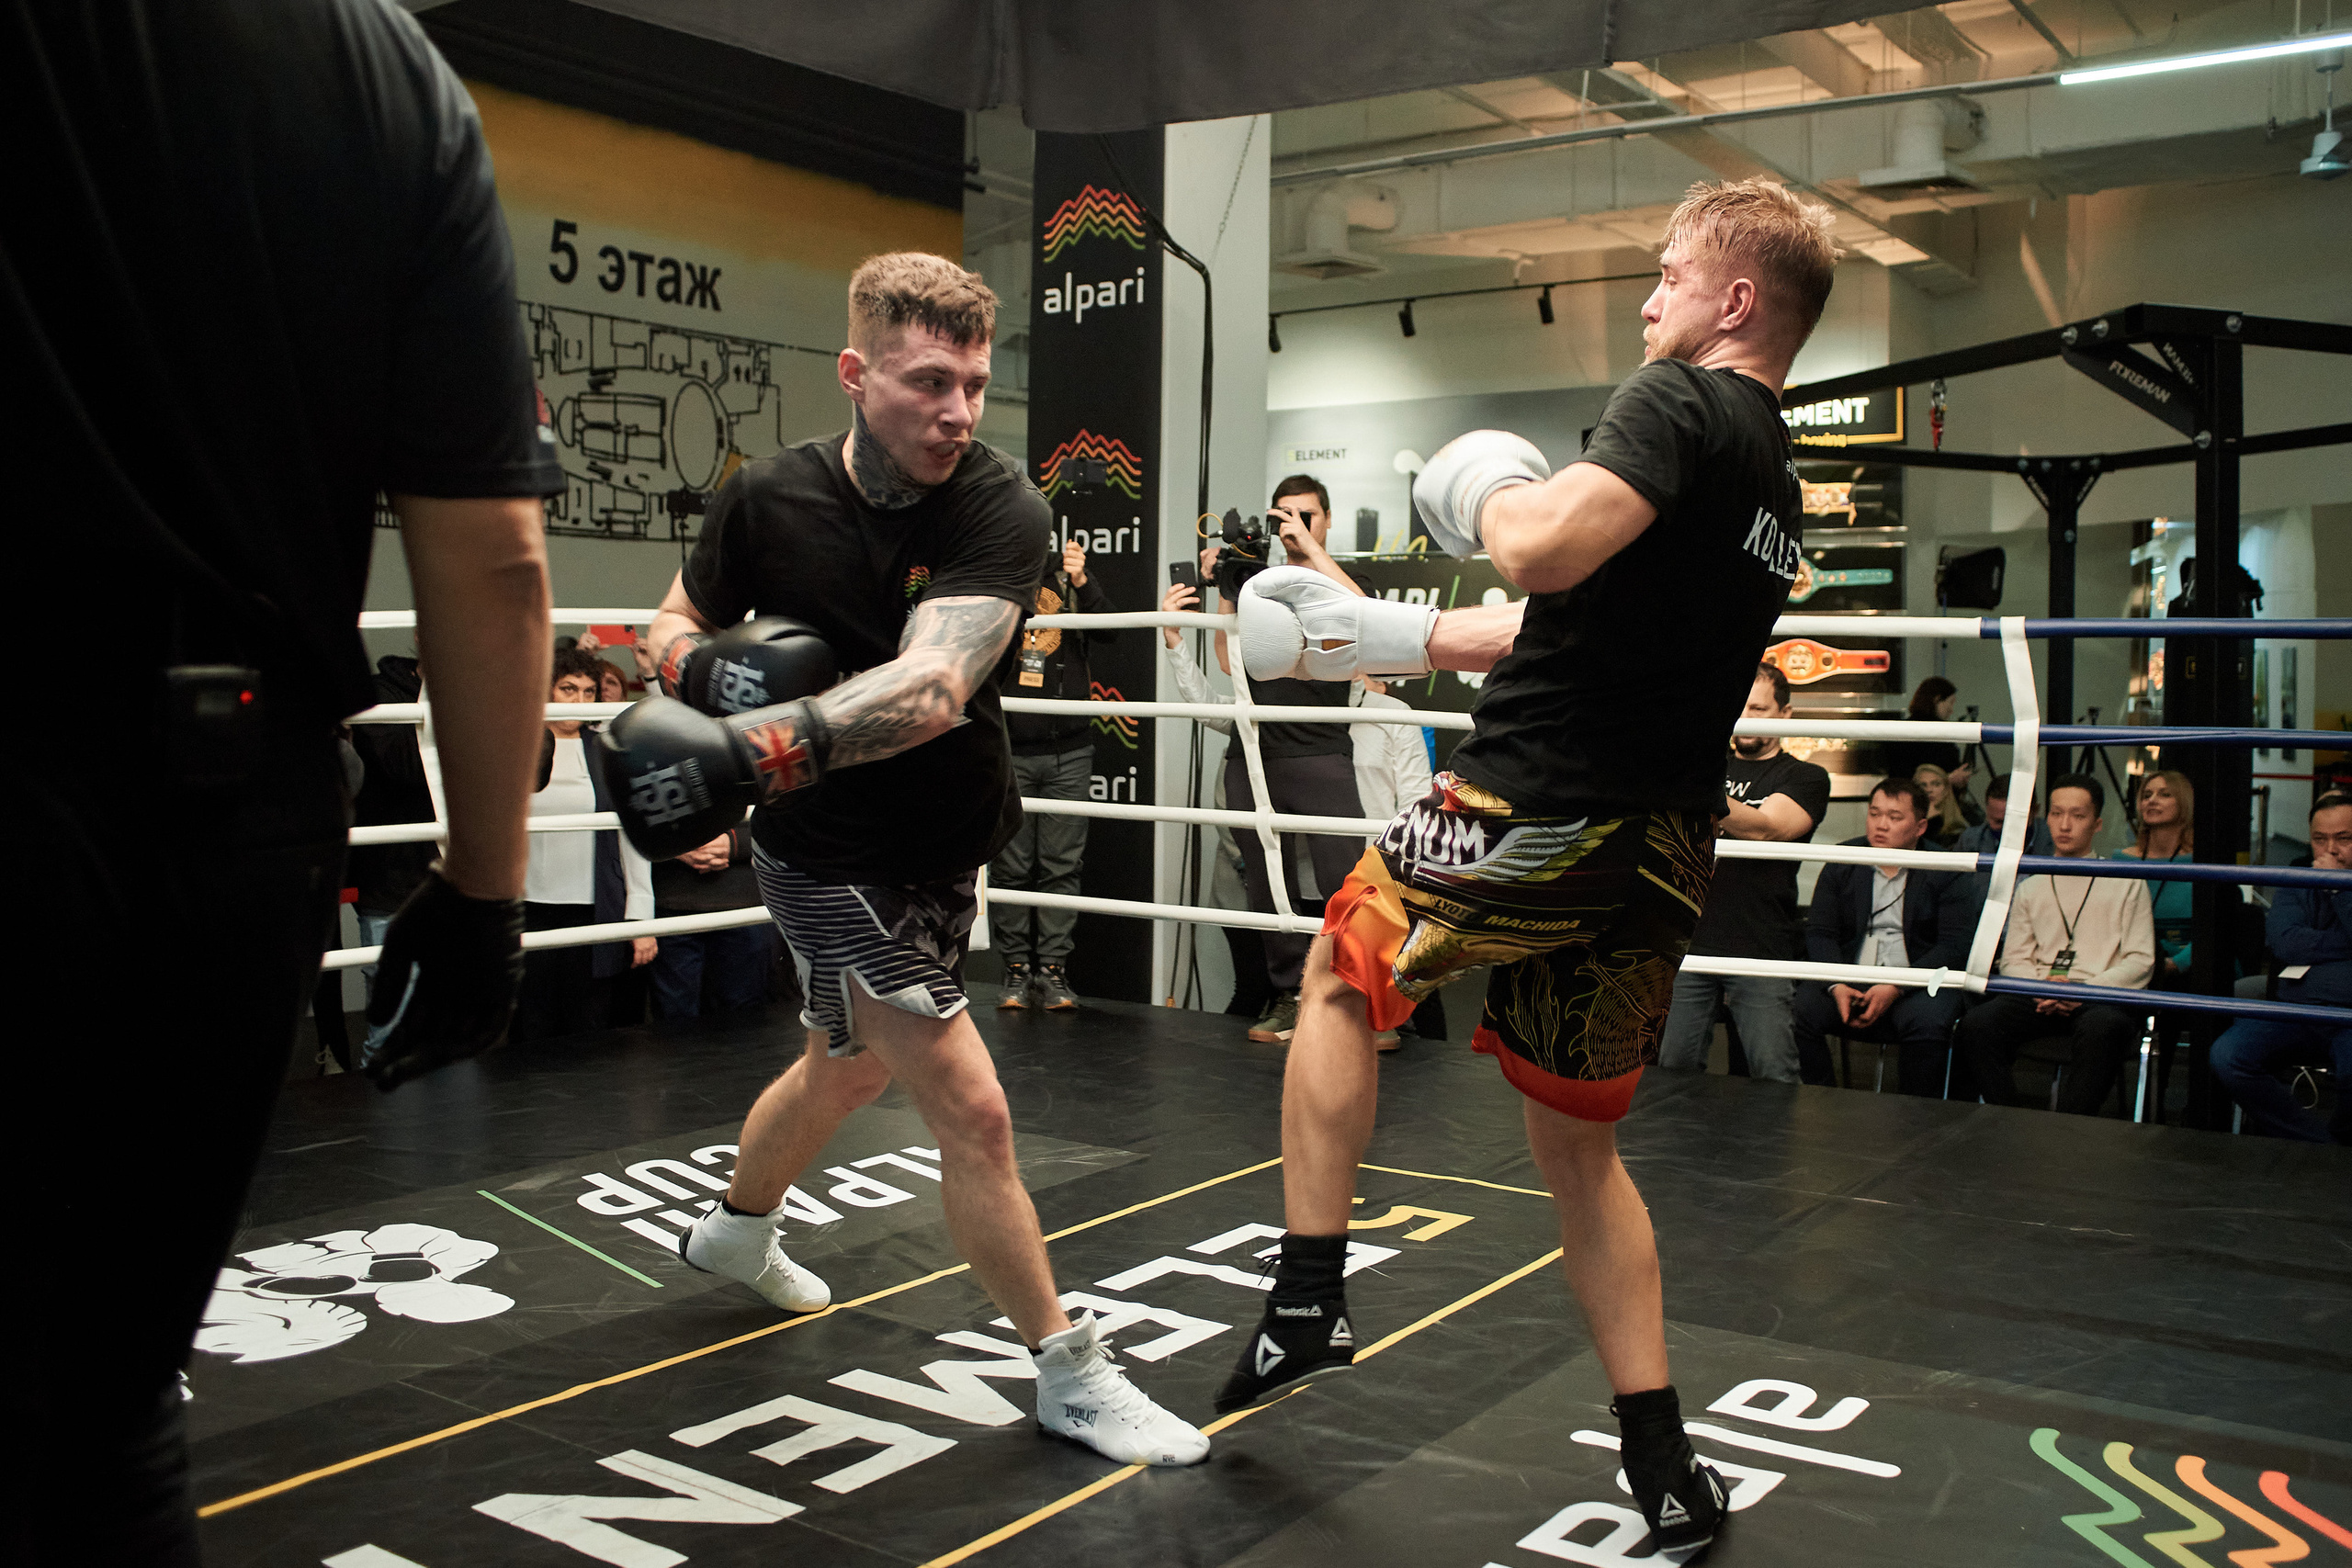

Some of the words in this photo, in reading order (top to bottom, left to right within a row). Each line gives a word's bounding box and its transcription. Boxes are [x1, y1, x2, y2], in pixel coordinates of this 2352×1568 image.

[549, 220, 578, 284] 5
[598, 244, 722, 312] этаж
[1044, 266, 1145, 323] alpari
[2109, 360, 2171, 403] FOREMAN
[1485, 915, 1581, 931] MACHIDA
[1065, 1404, 1099, 1427] EVERLAST
